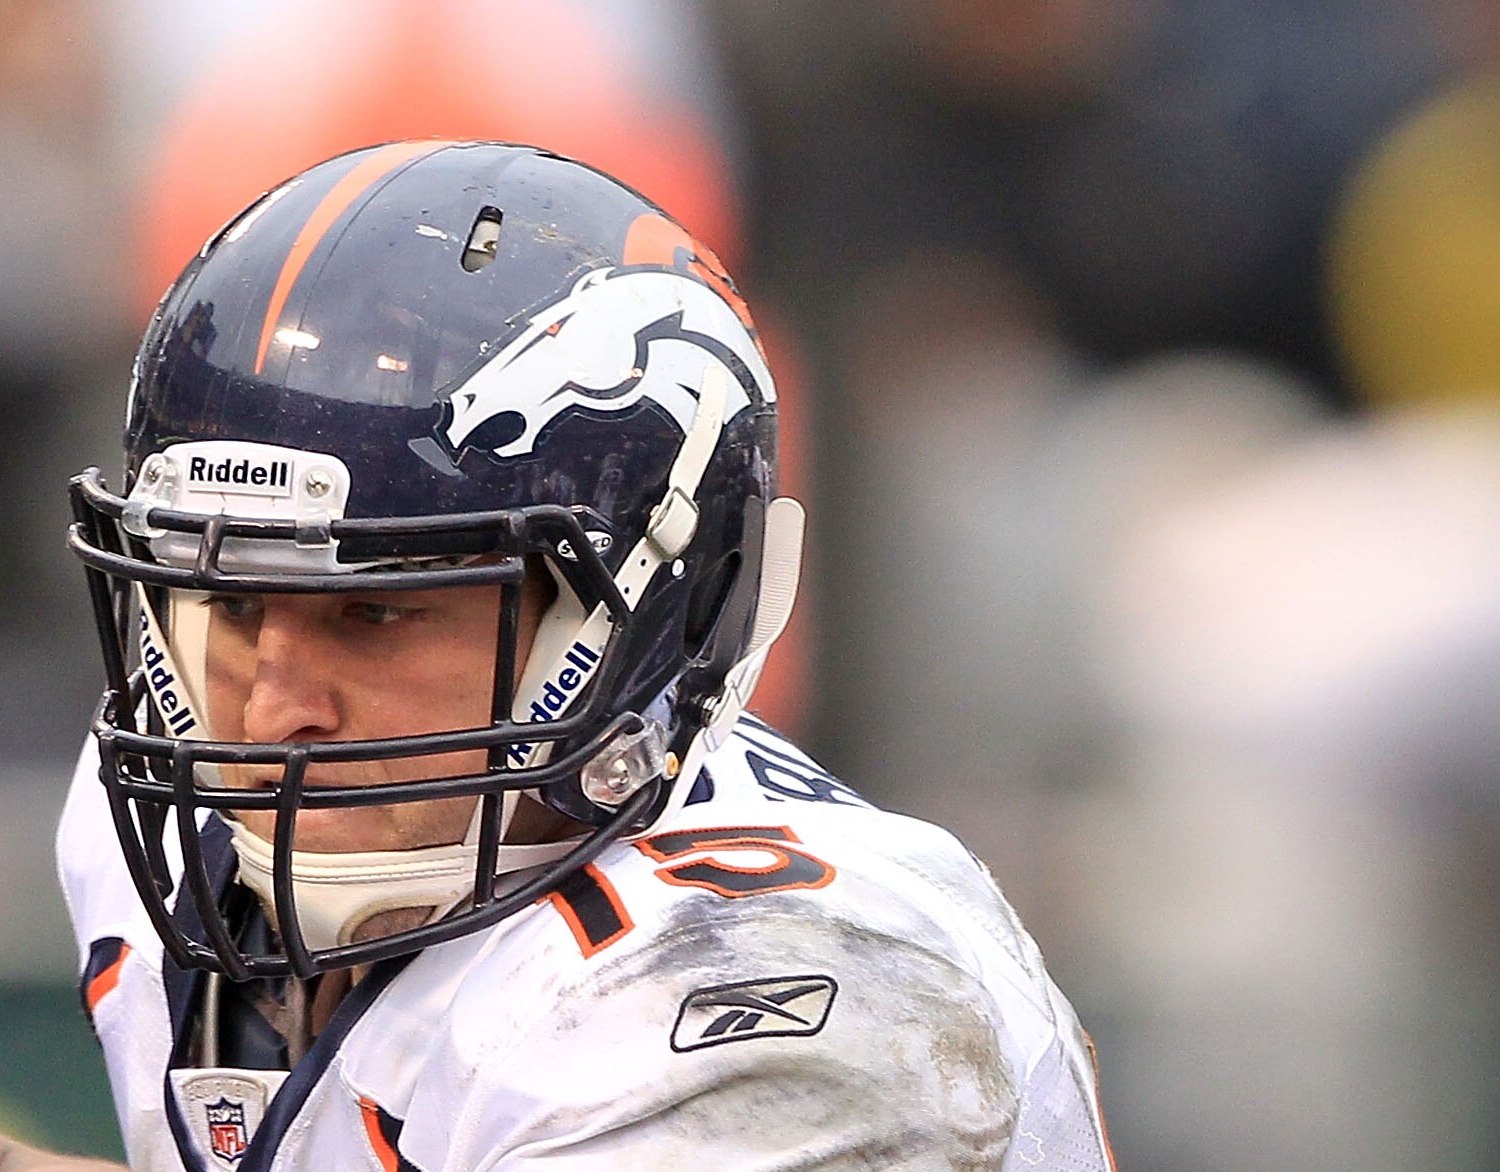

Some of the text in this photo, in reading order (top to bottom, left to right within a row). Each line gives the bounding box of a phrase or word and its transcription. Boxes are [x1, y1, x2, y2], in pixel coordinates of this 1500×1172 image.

[189, 456, 288, 487] Riddell
[507, 641, 600, 767] Rddell
[536, 823, 837, 960] 15
